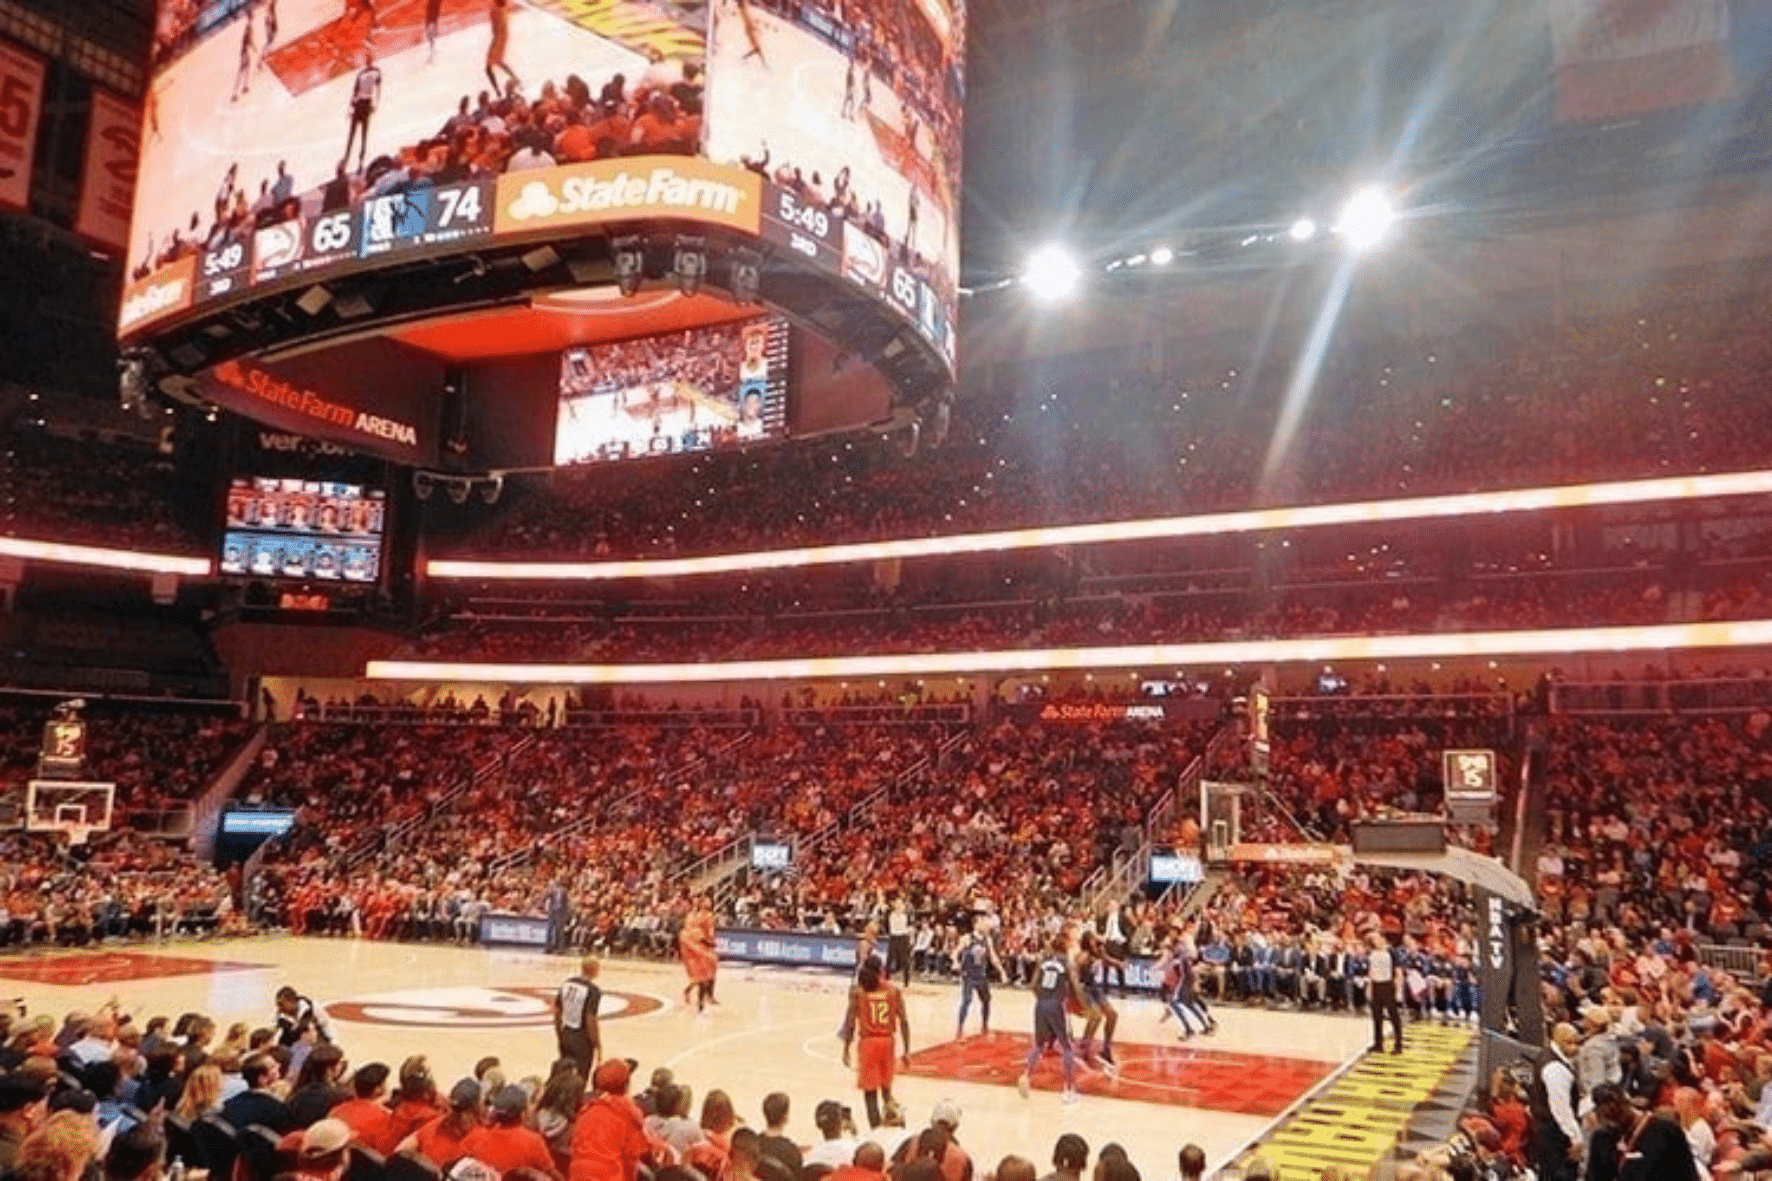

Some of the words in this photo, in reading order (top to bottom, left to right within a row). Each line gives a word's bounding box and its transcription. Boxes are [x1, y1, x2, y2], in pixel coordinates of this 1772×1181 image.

[437, 186, 482, 228] 74
[780, 192, 828, 238] 5:49
[313, 212, 351, 252] 65
[204, 243, 242, 275] 5:49
[893, 266, 916, 308] 65
[354, 412, 417, 445] ARENA
[869, 1001, 889, 1024] 12
